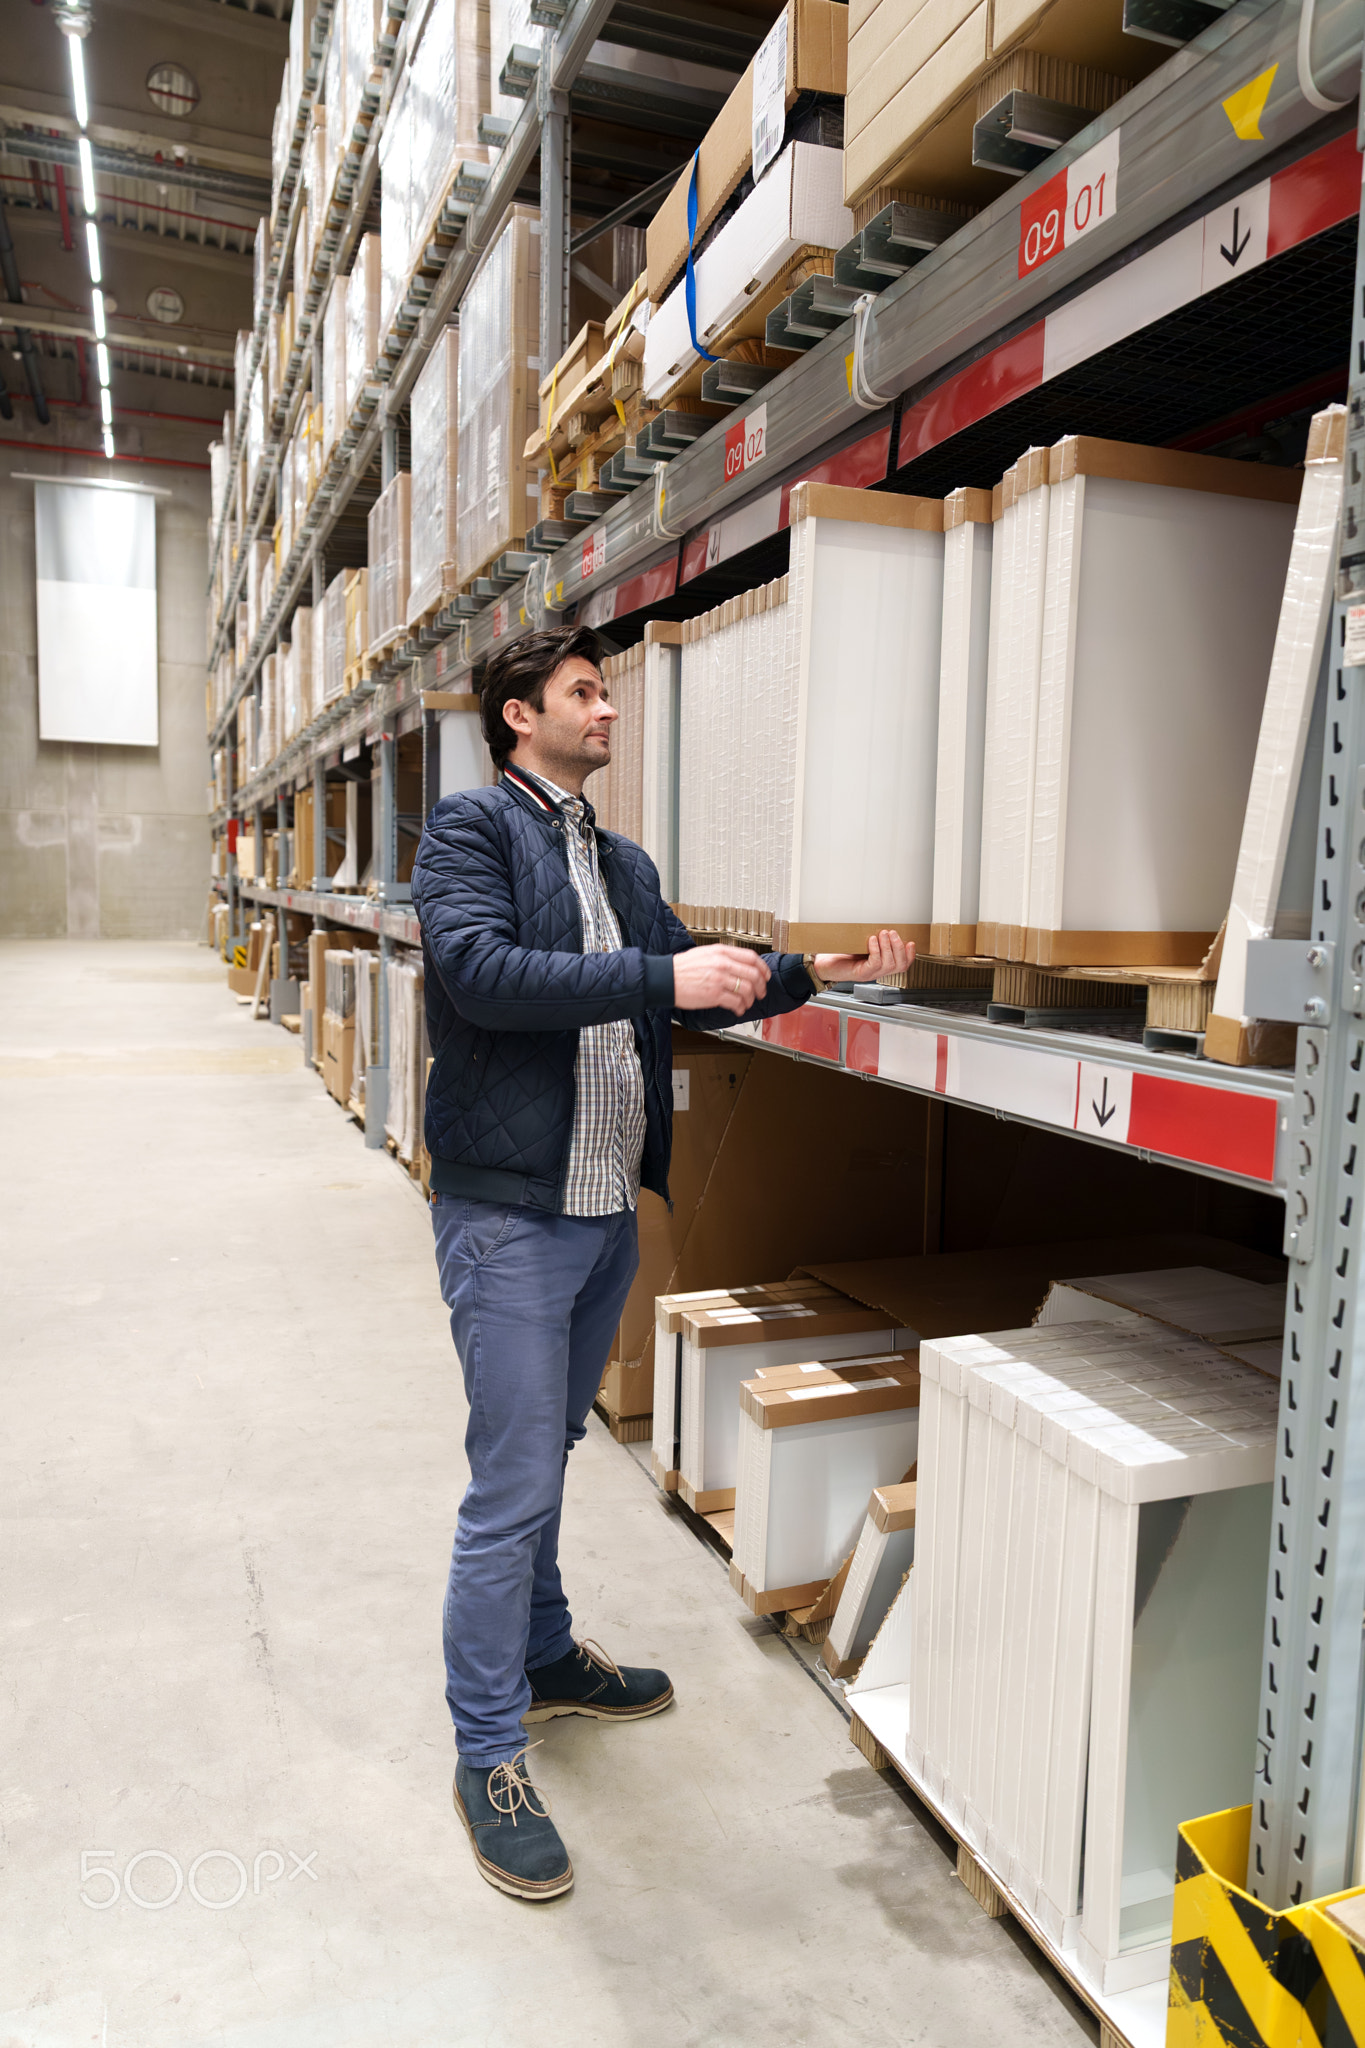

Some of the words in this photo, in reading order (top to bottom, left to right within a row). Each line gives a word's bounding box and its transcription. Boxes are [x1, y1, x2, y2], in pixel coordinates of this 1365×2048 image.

[1024, 209, 1060, 266] 09
[1073, 172, 1106, 232] 01
[726, 442, 742, 476] 09
[747, 427, 763, 462] 02
